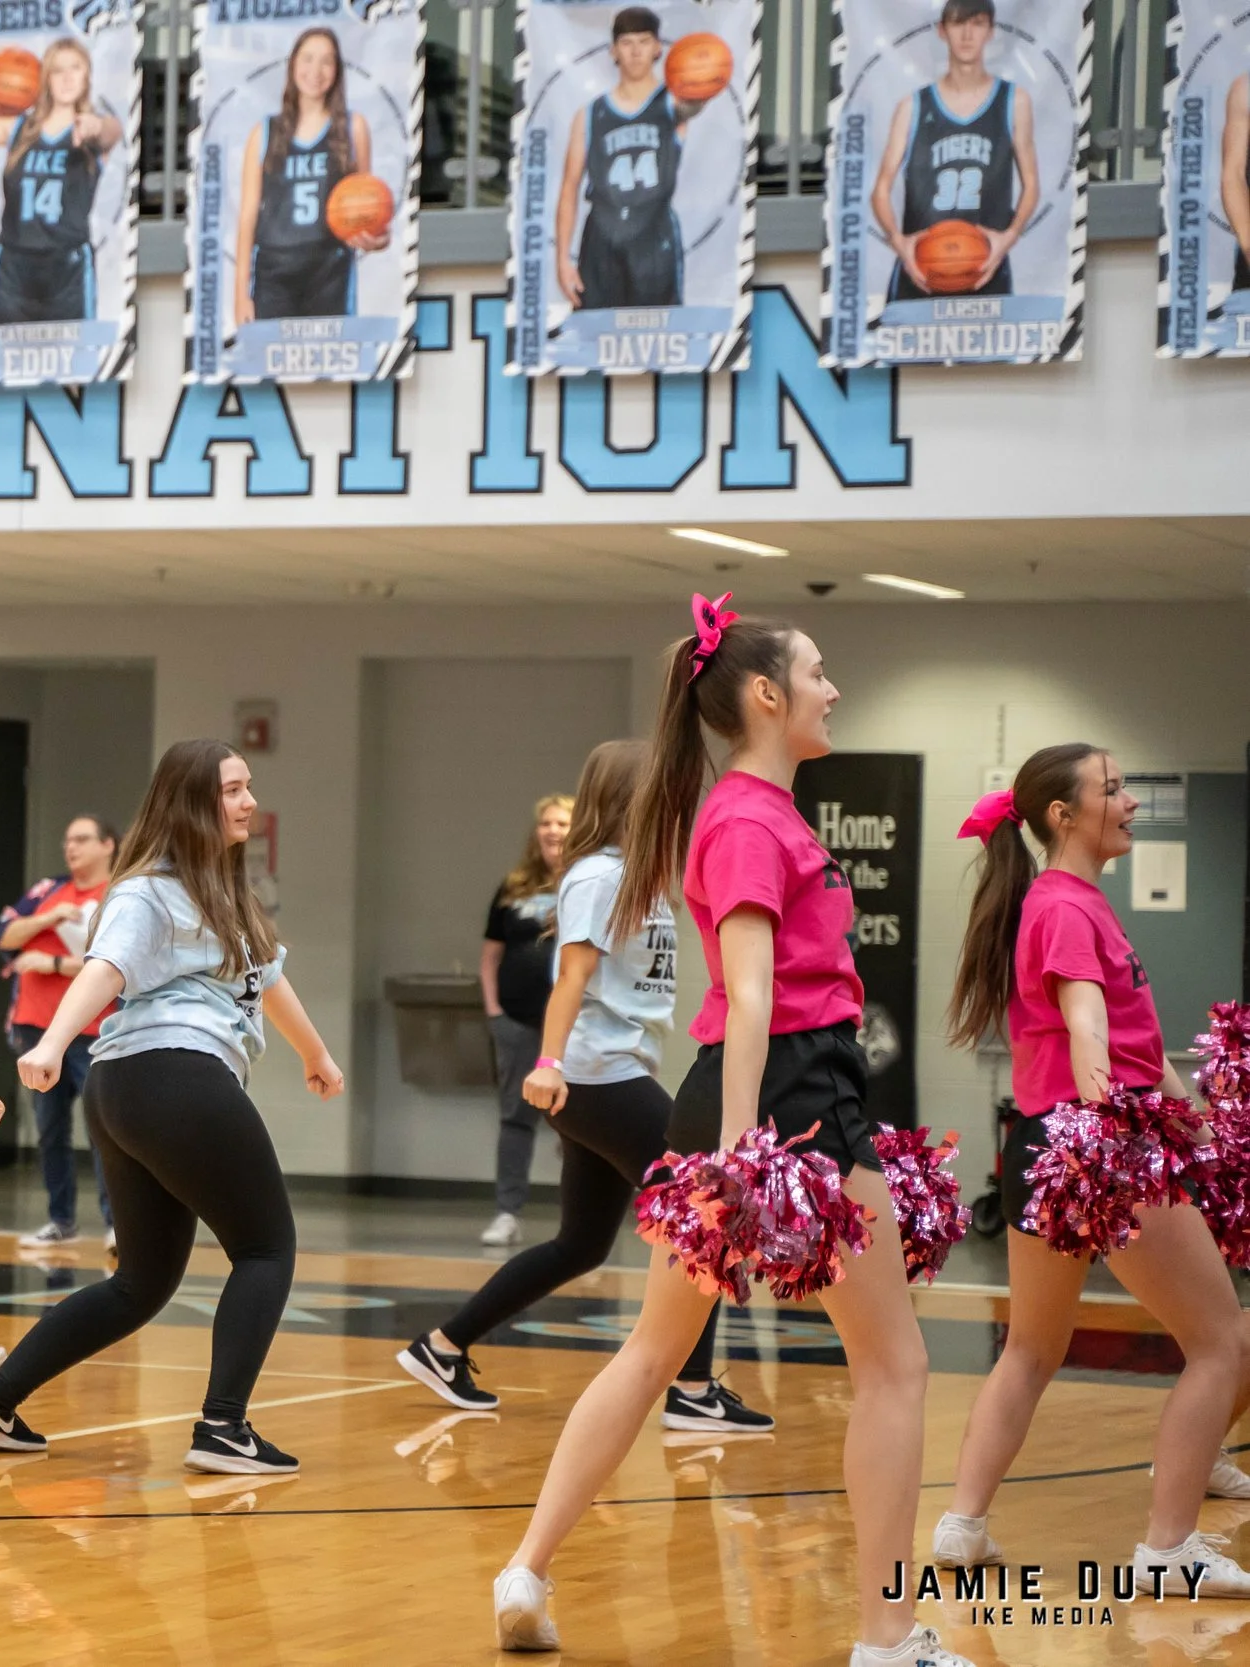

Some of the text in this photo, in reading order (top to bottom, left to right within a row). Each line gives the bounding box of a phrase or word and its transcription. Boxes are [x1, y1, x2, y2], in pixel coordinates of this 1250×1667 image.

[846, 114, 865, 155] ZOO
[1183, 97, 1203, 139] ZOO
[24, 149, 69, 174] IKE
[204, 144, 221, 182] ZOO
[285, 152, 329, 180] IKE
[529, 128, 547, 168] ZOO
[931, 132, 993, 168] TIGERS
[608, 150, 659, 191] 44
[843, 160, 863, 208] THE
[1180, 143, 1202, 194] THE
[19, 176, 64, 225] 14
[203, 187, 221, 233] THE
[292, 181, 320, 226] 5
[527, 173, 545, 219] THE
[842, 212, 861, 244] TO
[1179, 201, 1199, 232] TO
[202, 236, 218, 266] TO
[525, 225, 542, 255] TO
[933, 299, 1003, 320] LARSEN
[1175, 234, 1199, 349] WELCOME
[265, 342, 360, 375] CREES
[598, 332, 688, 365] DAVIS
[876, 321, 1062, 360] SCHNEIDER
[4, 346, 75, 377] EDDY
[818, 801, 897, 850] Home
[634, 981, 663, 994] BOYS
